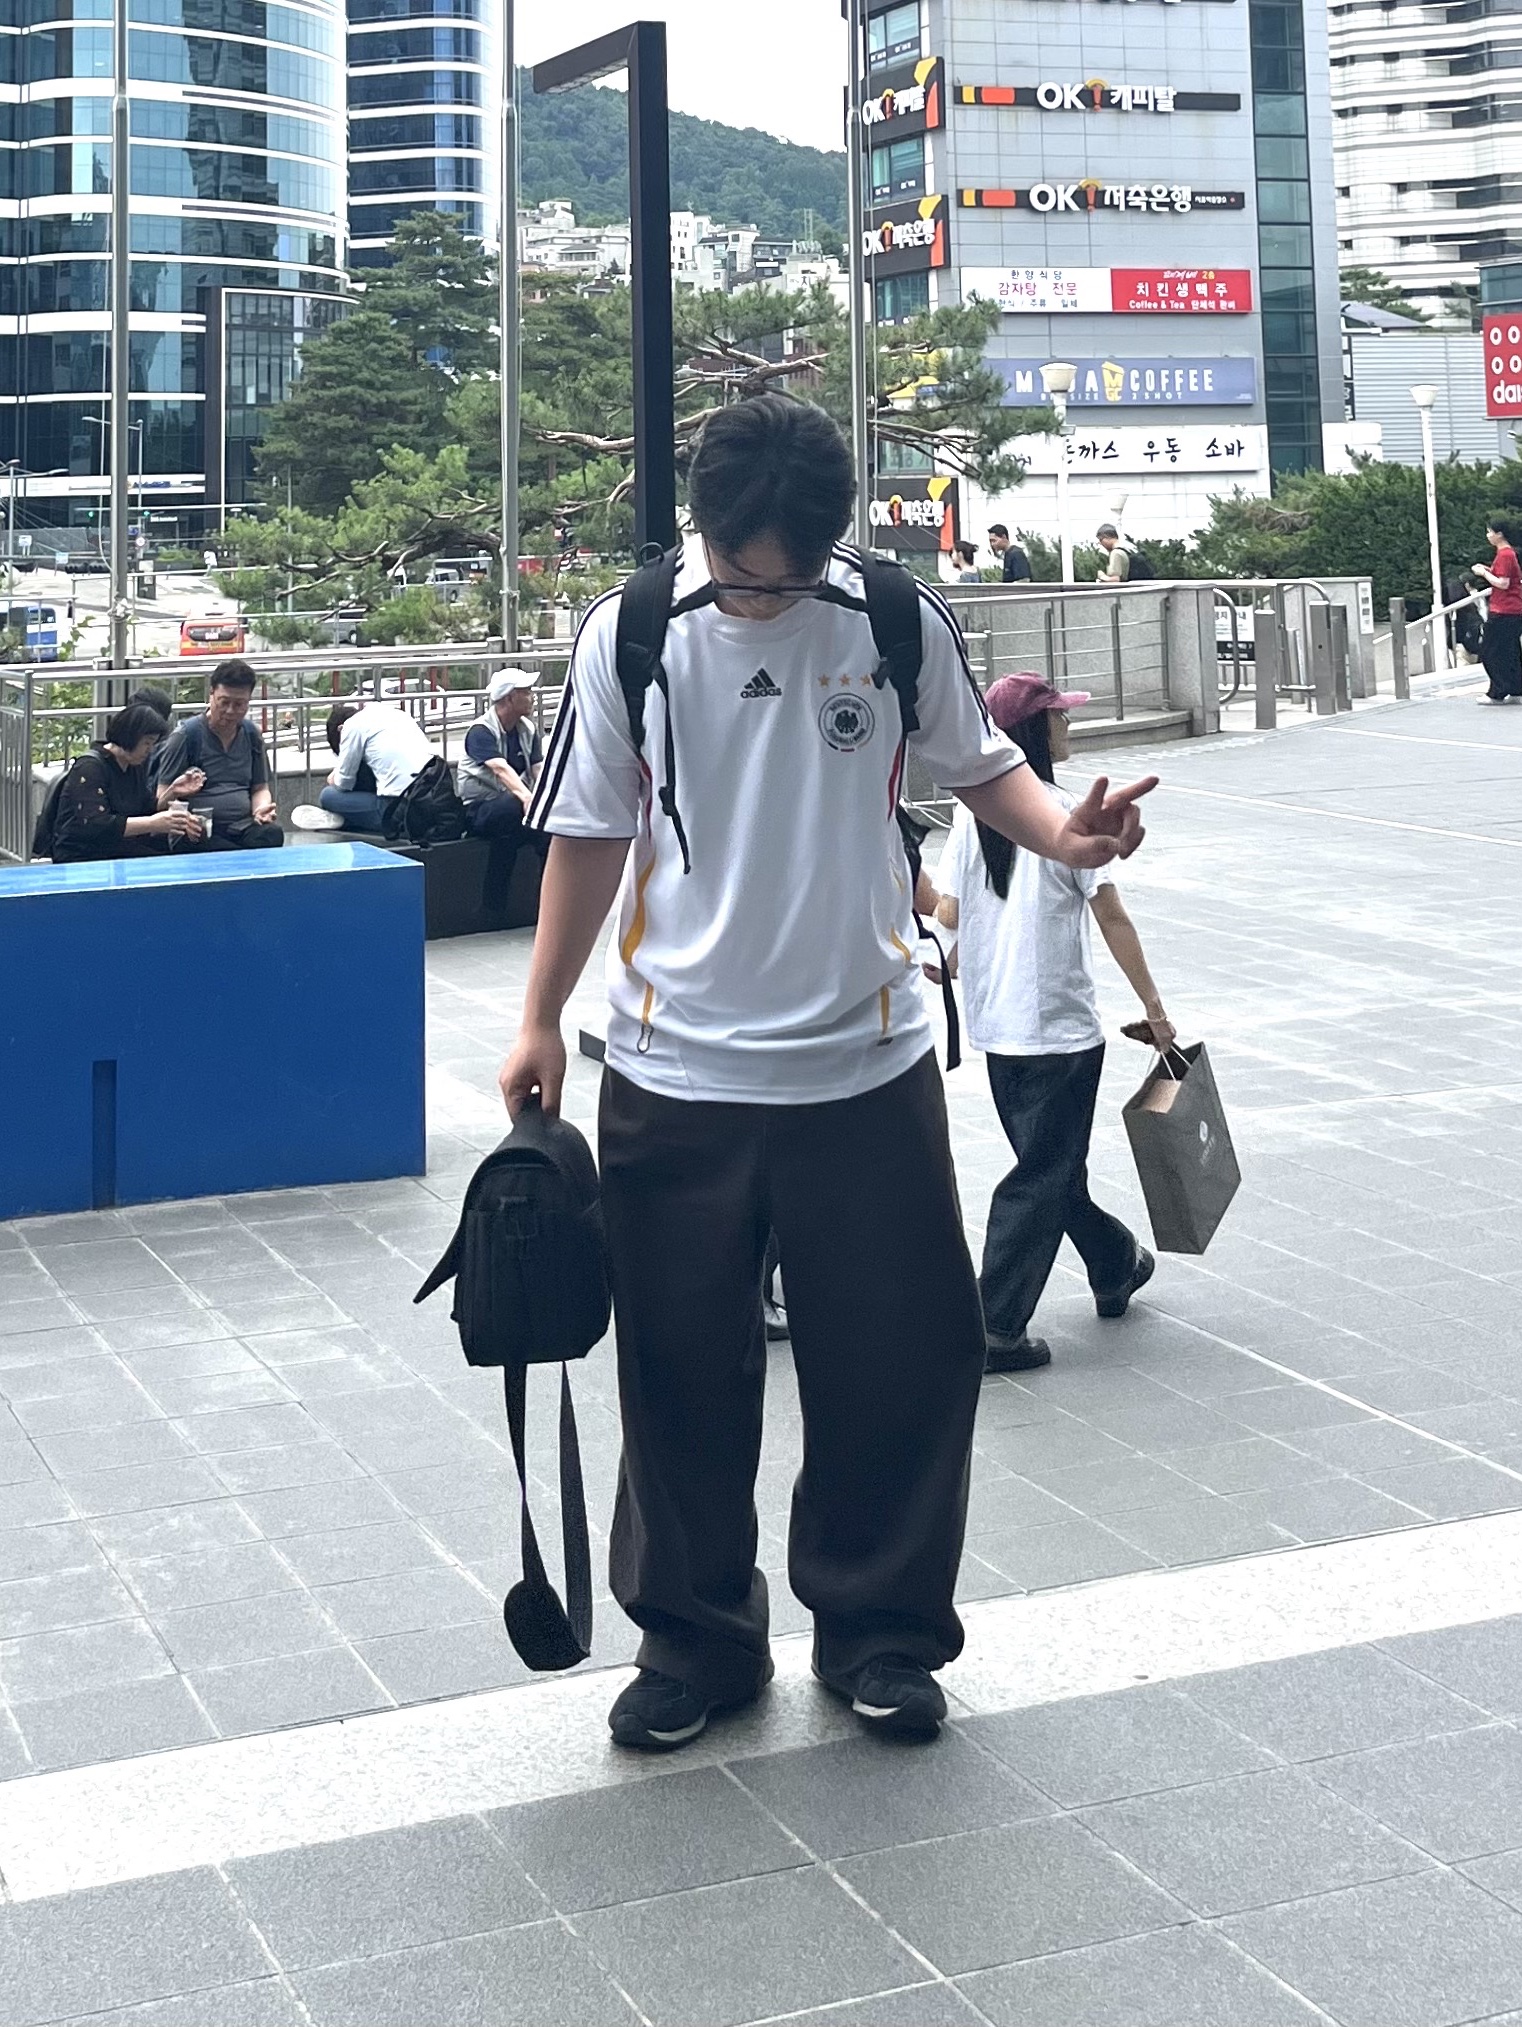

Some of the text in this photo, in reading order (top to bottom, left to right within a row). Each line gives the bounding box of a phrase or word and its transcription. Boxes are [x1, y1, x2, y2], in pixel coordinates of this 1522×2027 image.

[1110, 84, 1177, 112] 캐피탈
[1104, 184, 1192, 212] 저축은행
[998, 282, 1078, 296] 감자탕 전문
[1170, 300, 1185, 309] Tea
[1130, 369, 1213, 392] COFFEE
[1492, 379, 1522, 404] dai
[1143, 438, 1181, 463] 우동
[1205, 437, 1245, 458] 소바
[740, 686, 782, 699] adidas
